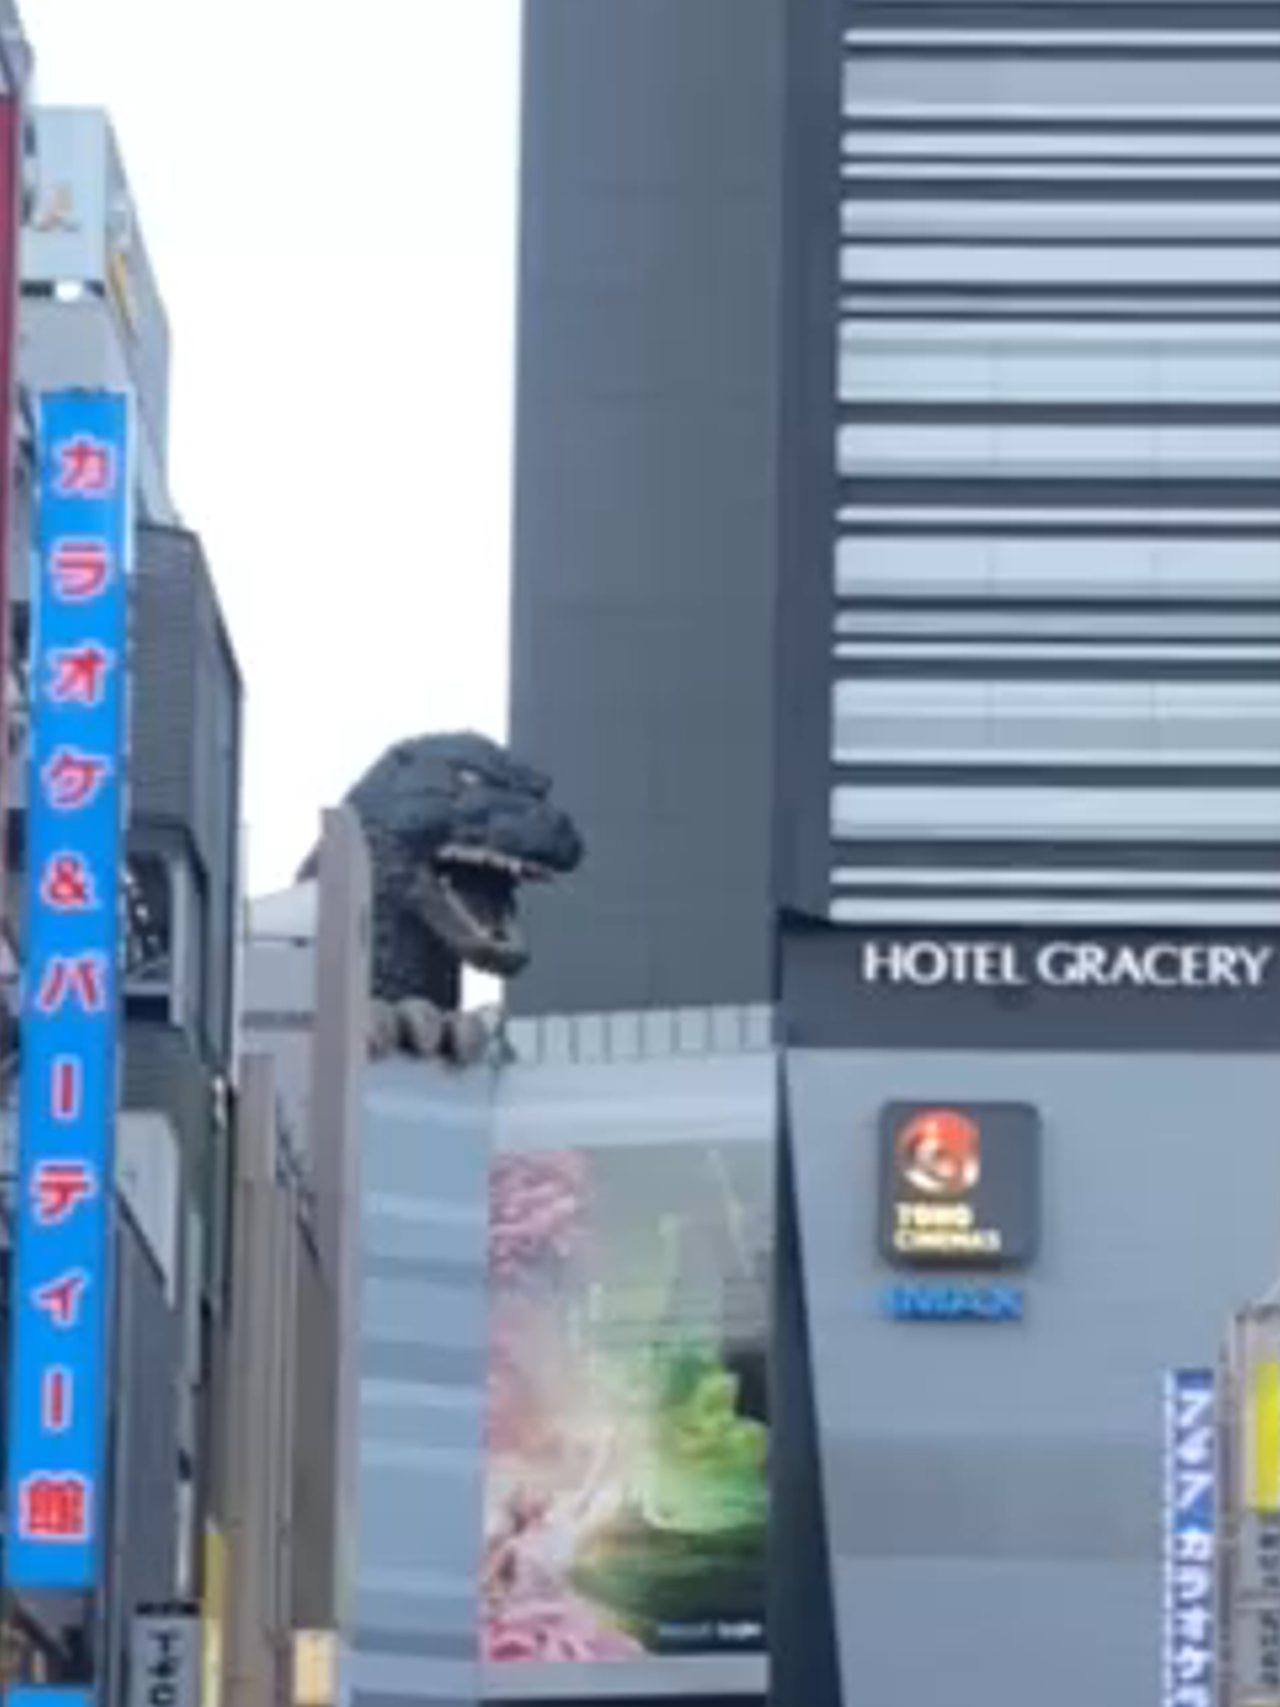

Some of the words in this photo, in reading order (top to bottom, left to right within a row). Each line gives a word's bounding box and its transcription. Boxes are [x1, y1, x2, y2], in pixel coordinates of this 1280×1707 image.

[862, 943, 1025, 986] HOTEL
[1036, 943, 1271, 986] GRACERY
[895, 1202, 973, 1228] TOHO
[894, 1228, 1002, 1253] CINEMAS
